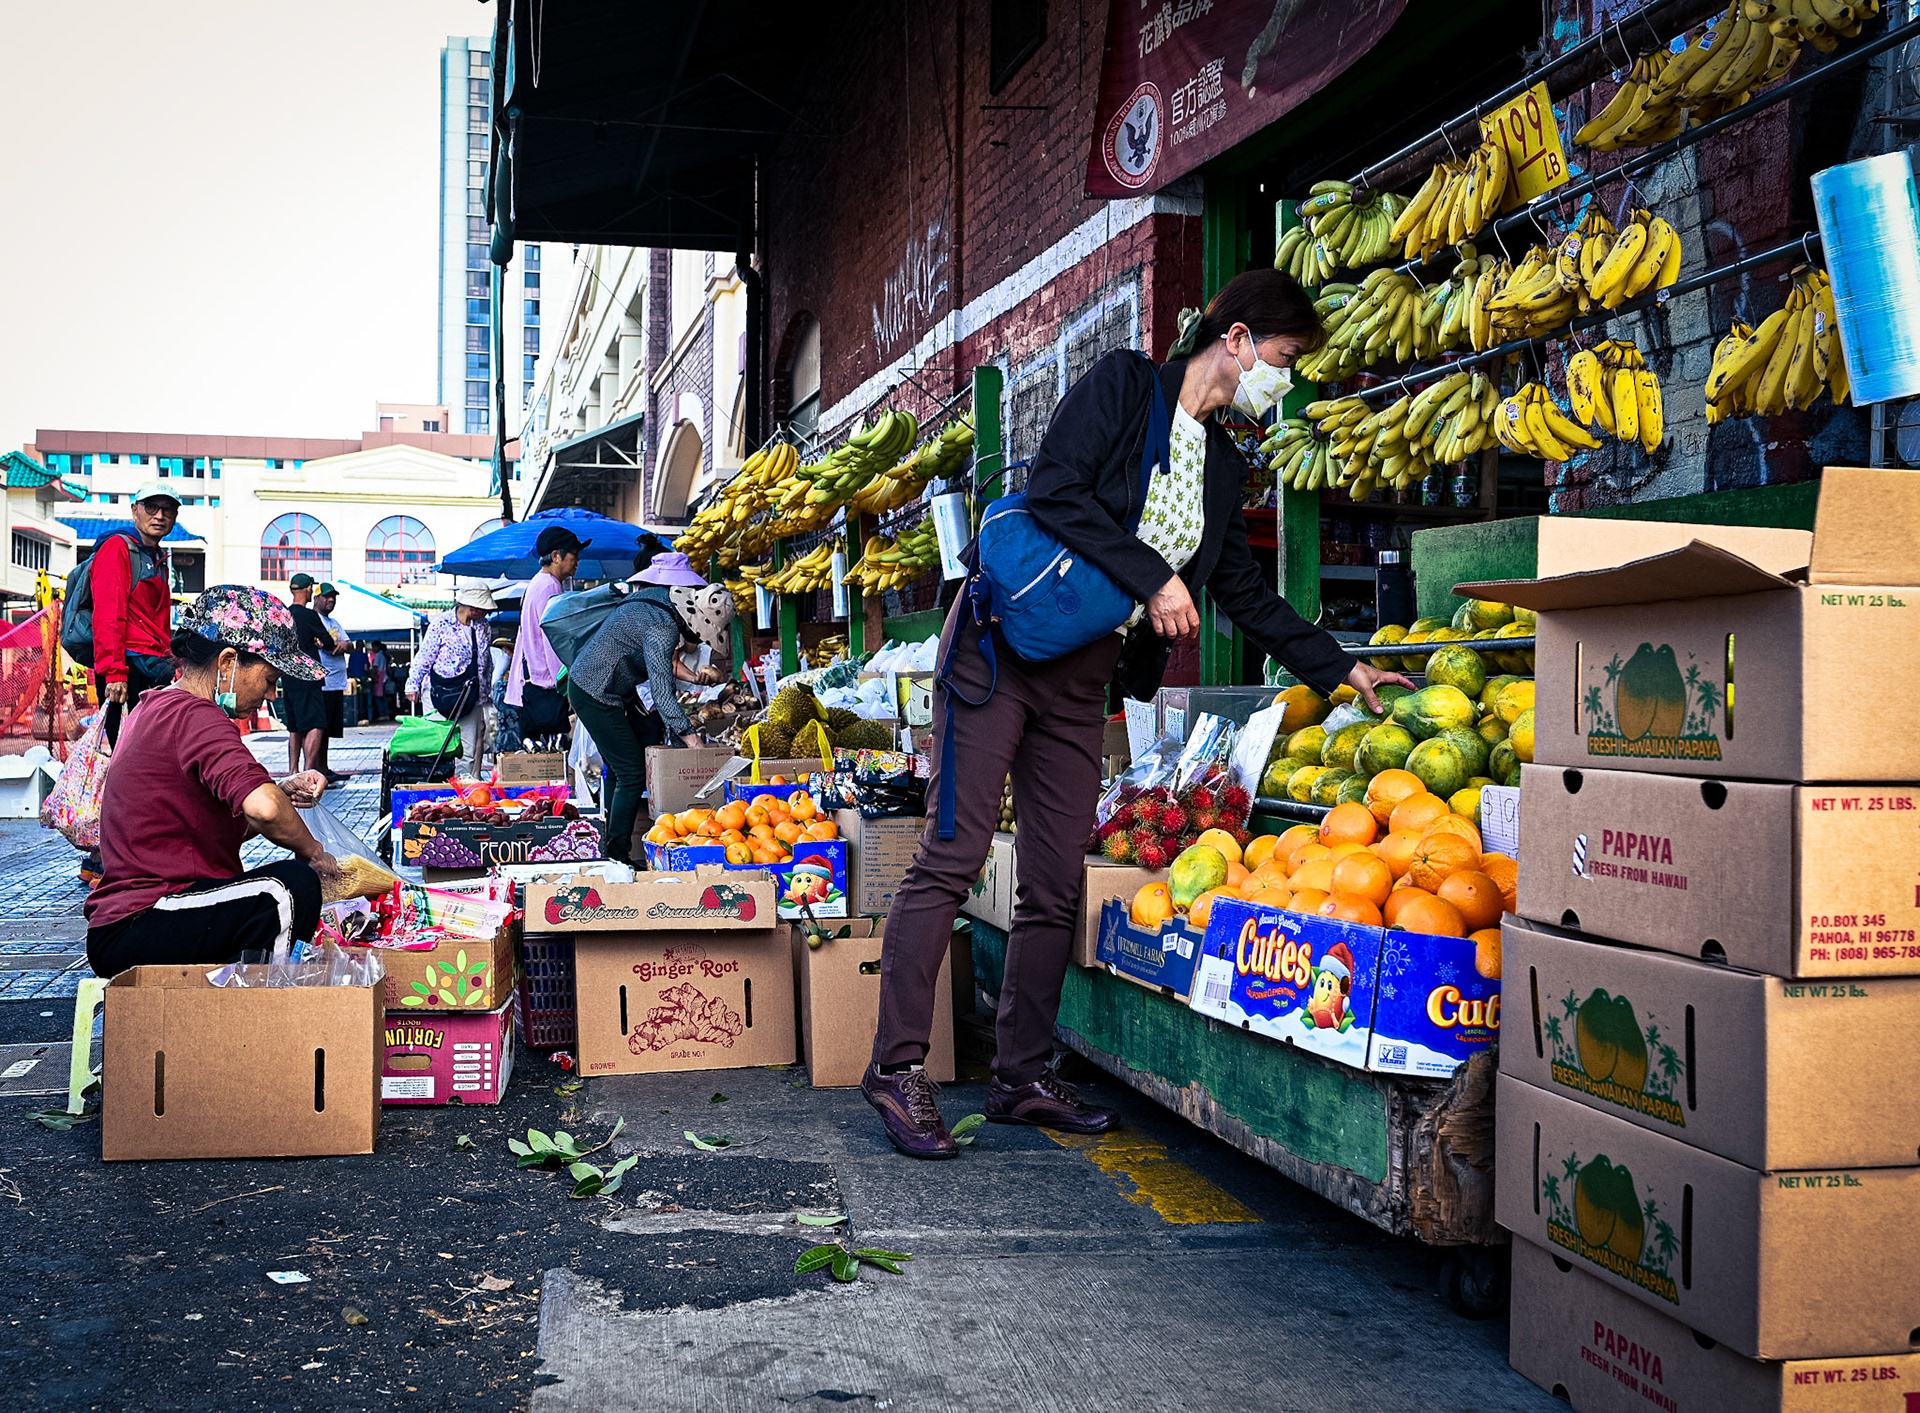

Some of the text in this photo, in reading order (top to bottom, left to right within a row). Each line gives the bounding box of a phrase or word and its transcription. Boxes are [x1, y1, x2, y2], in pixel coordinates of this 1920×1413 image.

[1543, 152, 1561, 182] LB
[1821, 594, 1907, 608] NET WT 25 lbs.
[1588, 736, 1721, 758] FRESH HAWAIIAN PAPAYA
[1812, 797, 1917, 811] NET WT. 25 LBS.
[480, 840, 532, 865] PEONY
[1602, 828, 1673, 865] PAPAYA
[1588, 860, 1688, 891] FRESH FROM HAWAII
[558, 902, 742, 924] California Strawberries
[1810, 914, 1886, 928] P.O.BOX 345
[1810, 929, 1915, 945] PAHOA, HI 96778
[1143, 945, 1166, 969] FARMS
[1236, 916, 1314, 991] Cuties
[1810, 948, 1831, 961] PH:
[1836, 947, 1868, 962] (808)
[632, 960, 739, 982] Ginger Root
[1784, 984, 1868, 998] NET WT 25 lbs.
[670, 1050, 691, 1059] GRADE
[590, 1062, 616, 1070] GROWER
[1552, 1064, 1684, 1126] FRESH HAWAIIAN PAPAYA
[1779, 1173, 1863, 1188] NET WT 25 lbs.
[1548, 1223, 1678, 1304] FRESH HAWAIIAN PAPAYA
[1594, 1320, 1663, 1385] PAPAYA
[1581, 1345, 1678, 1413] FRESH FROM HAWAII
[1794, 1367, 1901, 1384] NET WT. 25 LBS.
